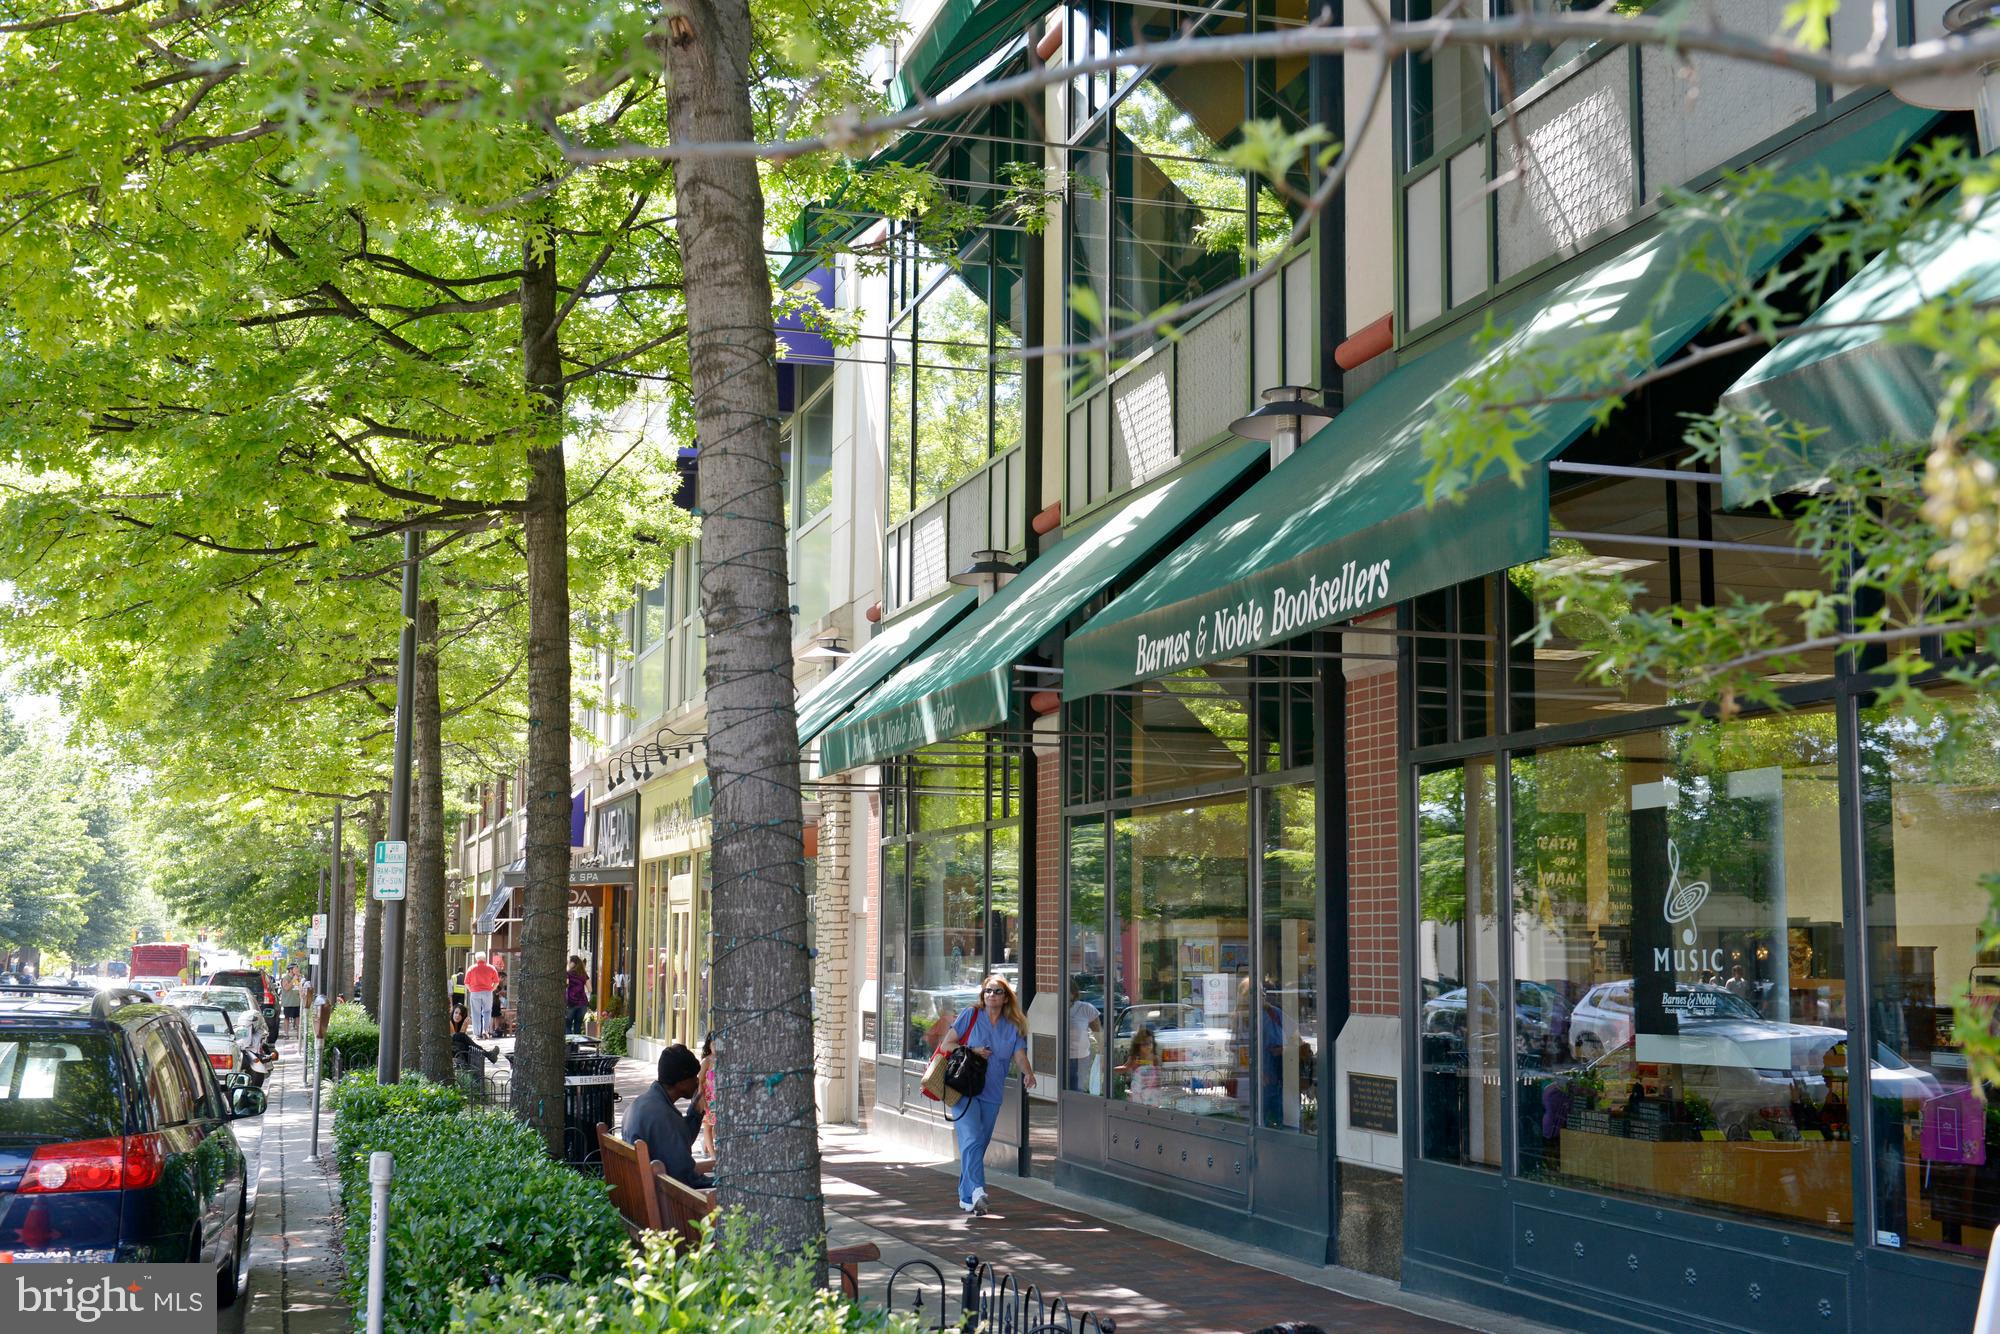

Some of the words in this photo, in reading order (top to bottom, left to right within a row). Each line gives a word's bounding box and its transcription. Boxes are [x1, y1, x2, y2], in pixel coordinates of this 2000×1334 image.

[1135, 630, 1190, 676] Barnes
[1195, 615, 1208, 659] &
[1211, 598, 1264, 655] Noble
[1270, 558, 1391, 637] Booksellers
[852, 733, 877, 760] Barnes
[878, 724, 885, 752] &
[885, 717, 907, 749] Noble
[597, 805, 630, 857] AVEDA
[569, 873, 576, 881] &
[580, 872, 599, 881] SPA
[1653, 947, 1723, 972] MUSIC
[1662, 992, 1687, 1005] Barnes
[1687, 992, 1696, 1009] &
[1695, 992, 1717, 1006] Noble
[579, 1076, 611, 1084] BETHESDA
[13, 1250, 71, 1260] SIENNA
